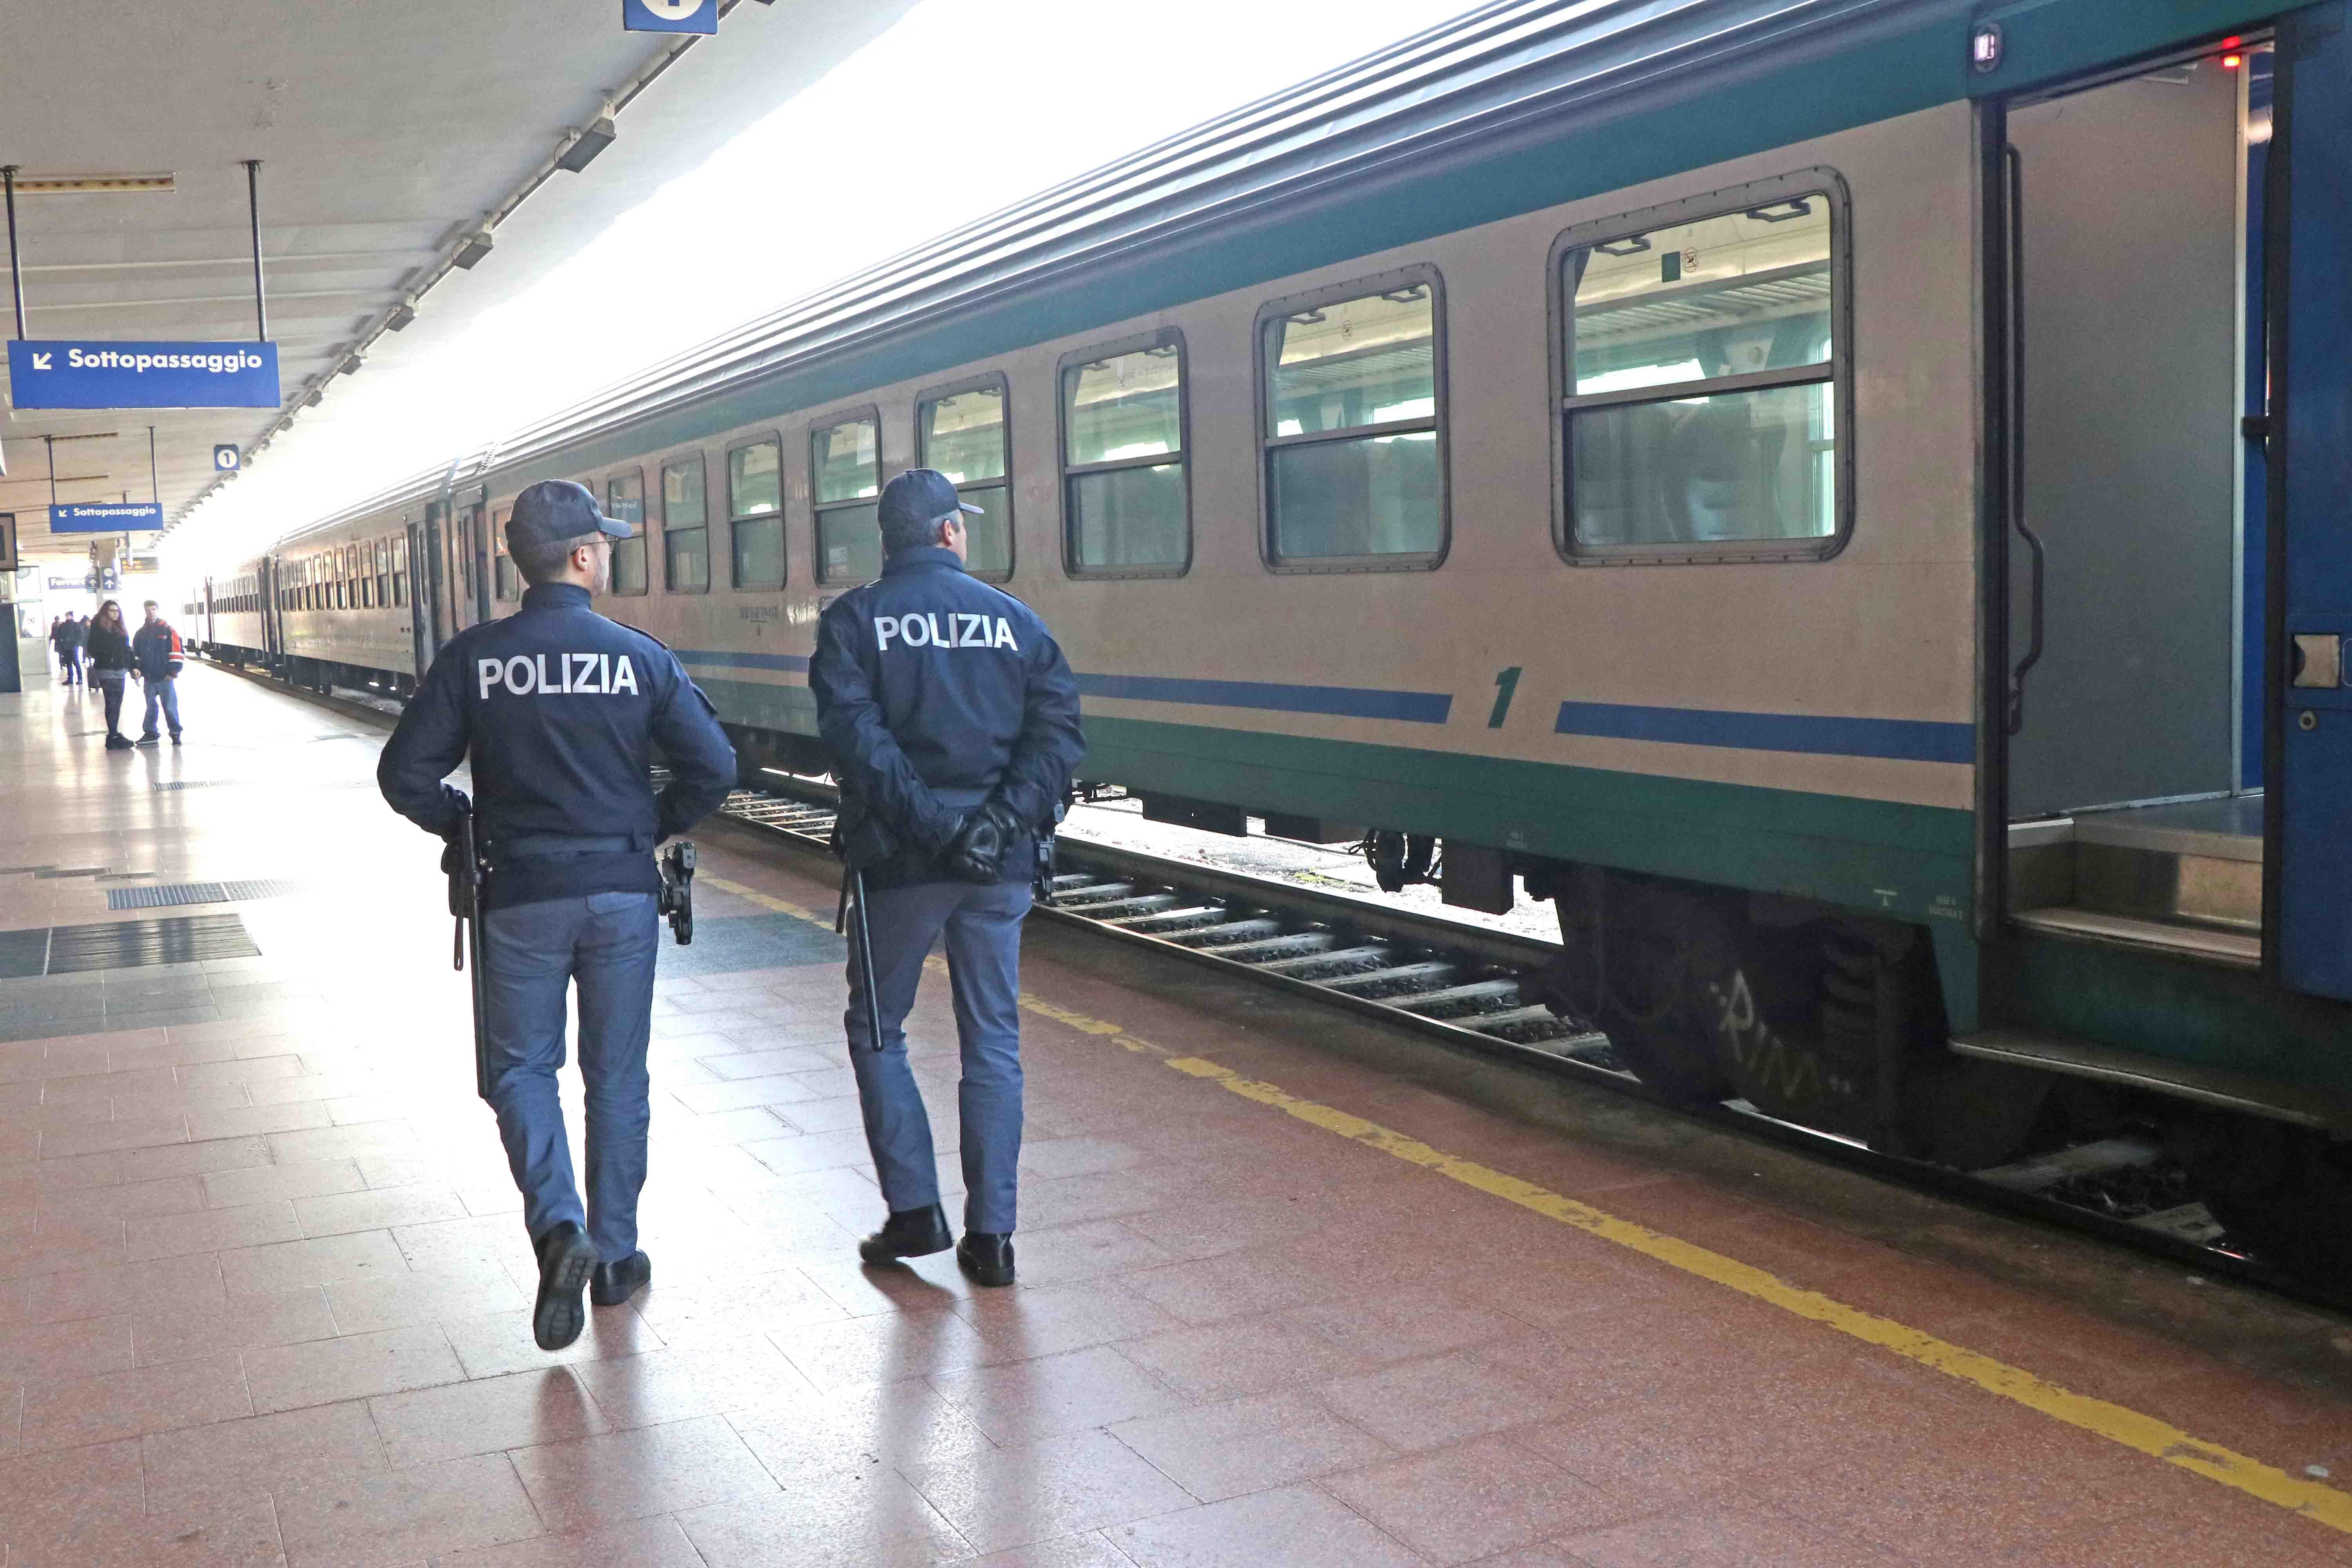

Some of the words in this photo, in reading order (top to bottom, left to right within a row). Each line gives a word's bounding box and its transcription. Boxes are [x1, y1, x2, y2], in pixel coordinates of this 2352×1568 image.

[69, 348, 262, 373] Sottopassaggio
[224, 453, 230, 464] 1
[73, 506, 156, 517] Sottopassaggio
[874, 612, 1019, 652] POLIZIA
[478, 653, 639, 700] POLIZIA
[1487, 666, 1523, 728] 1
